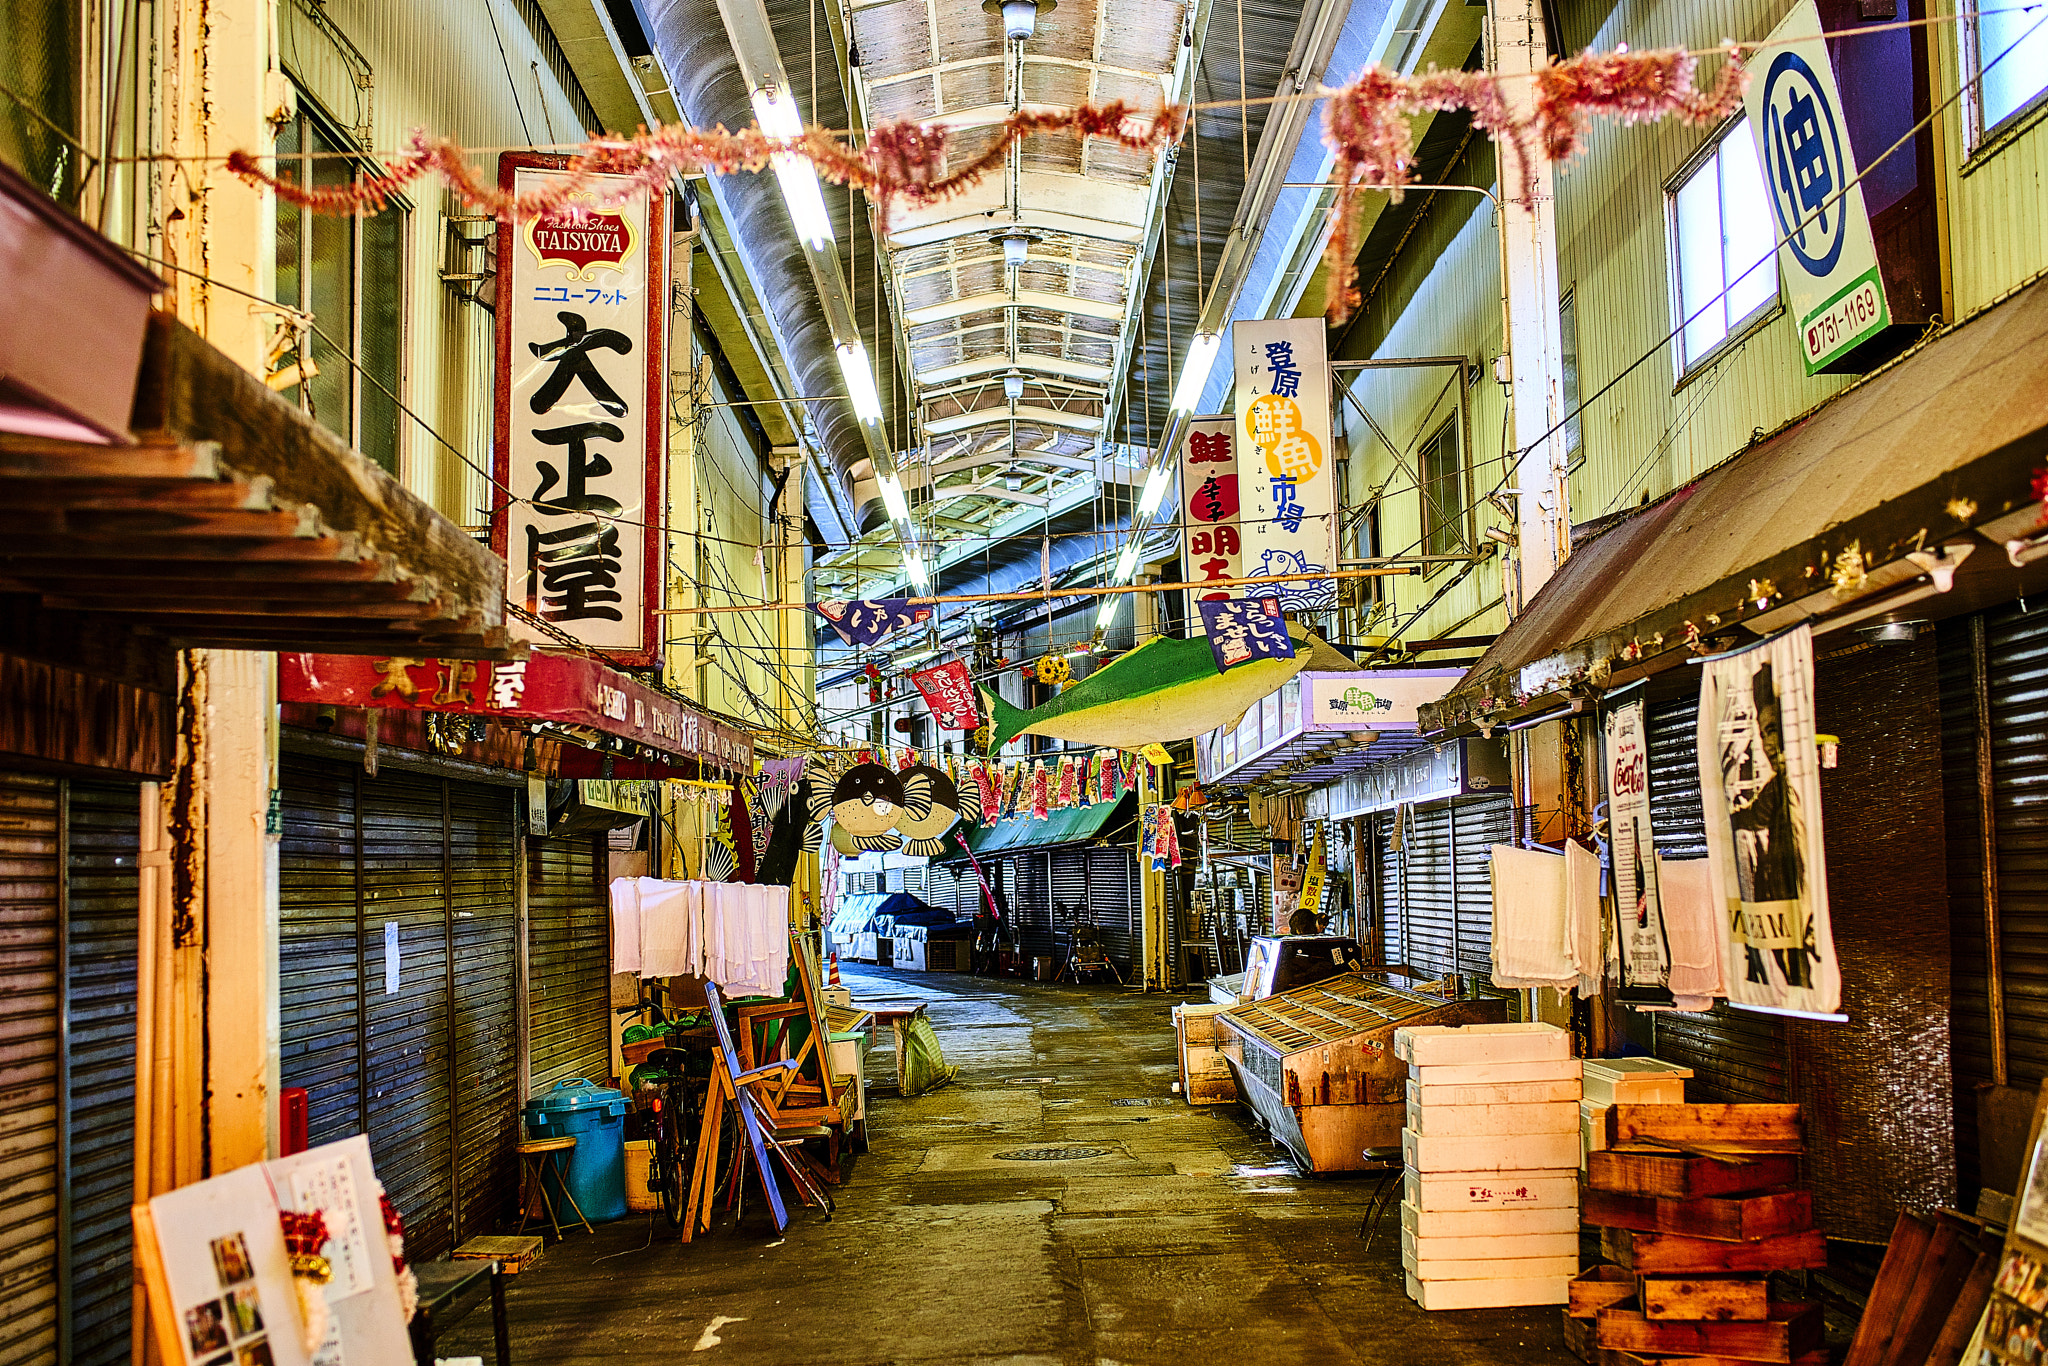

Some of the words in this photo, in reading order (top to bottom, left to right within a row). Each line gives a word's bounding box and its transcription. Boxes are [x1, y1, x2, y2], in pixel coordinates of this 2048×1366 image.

[537, 230, 623, 253] TAISYOYA
[588, 218, 620, 232] Shoes
[533, 286, 628, 306] ニューフット
[1818, 288, 1876, 350] 751-1169
[525, 311, 633, 622] 大正屋
[371, 656, 526, 709] 大正屋
